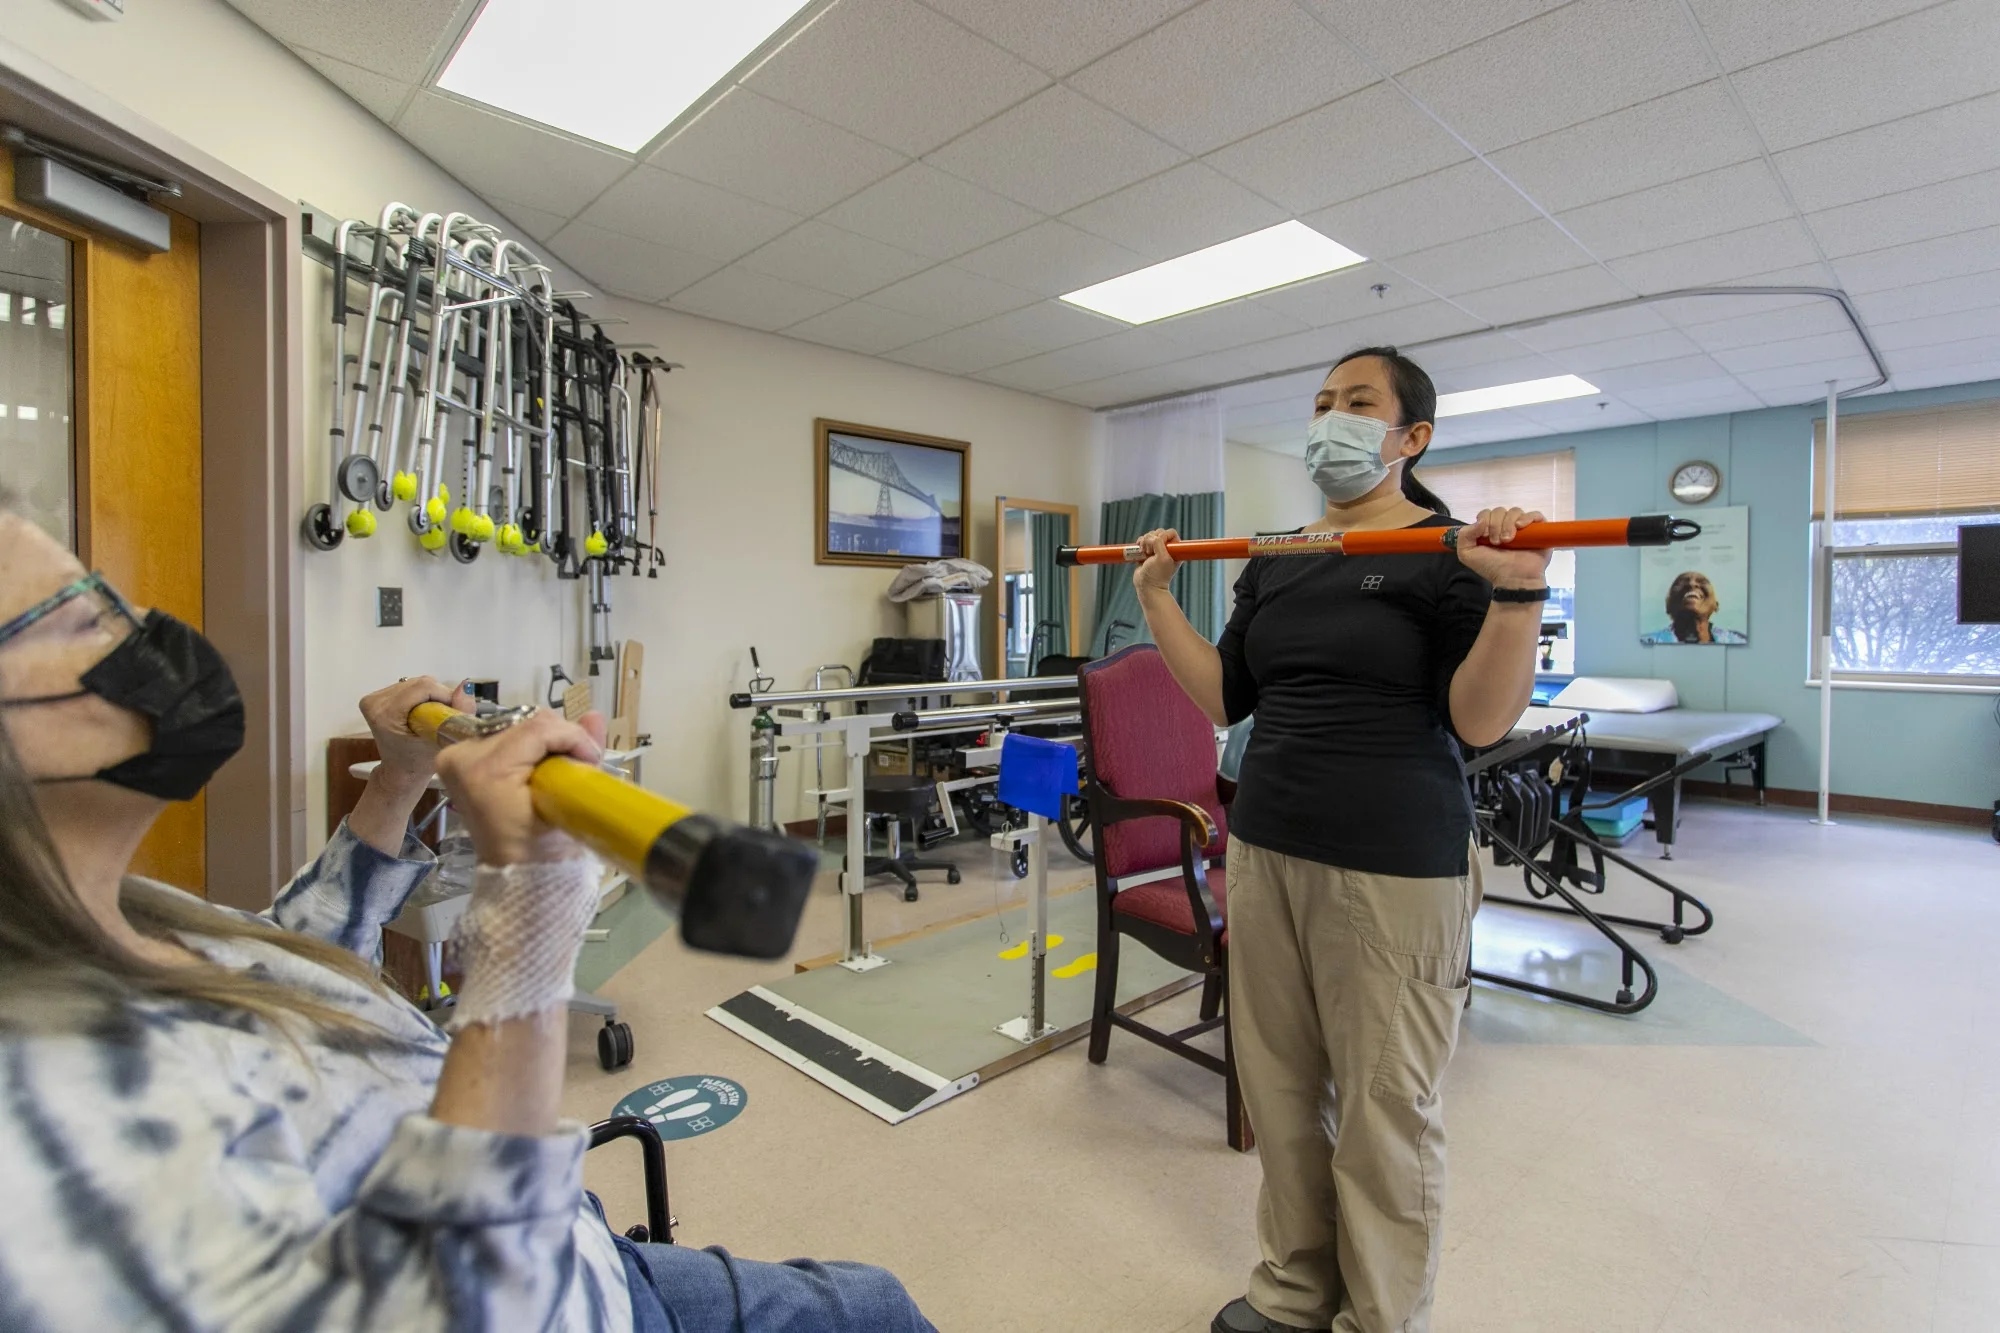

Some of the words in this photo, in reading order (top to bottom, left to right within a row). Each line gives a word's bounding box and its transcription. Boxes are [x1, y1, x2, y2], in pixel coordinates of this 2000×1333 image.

[1307, 533, 1334, 543] BAR
[1277, 547, 1326, 555] CONDITIONING
[700, 1078, 735, 1092] PLEASE
[727, 1091, 739, 1106] STAY
[702, 1084, 721, 1092] FEET
